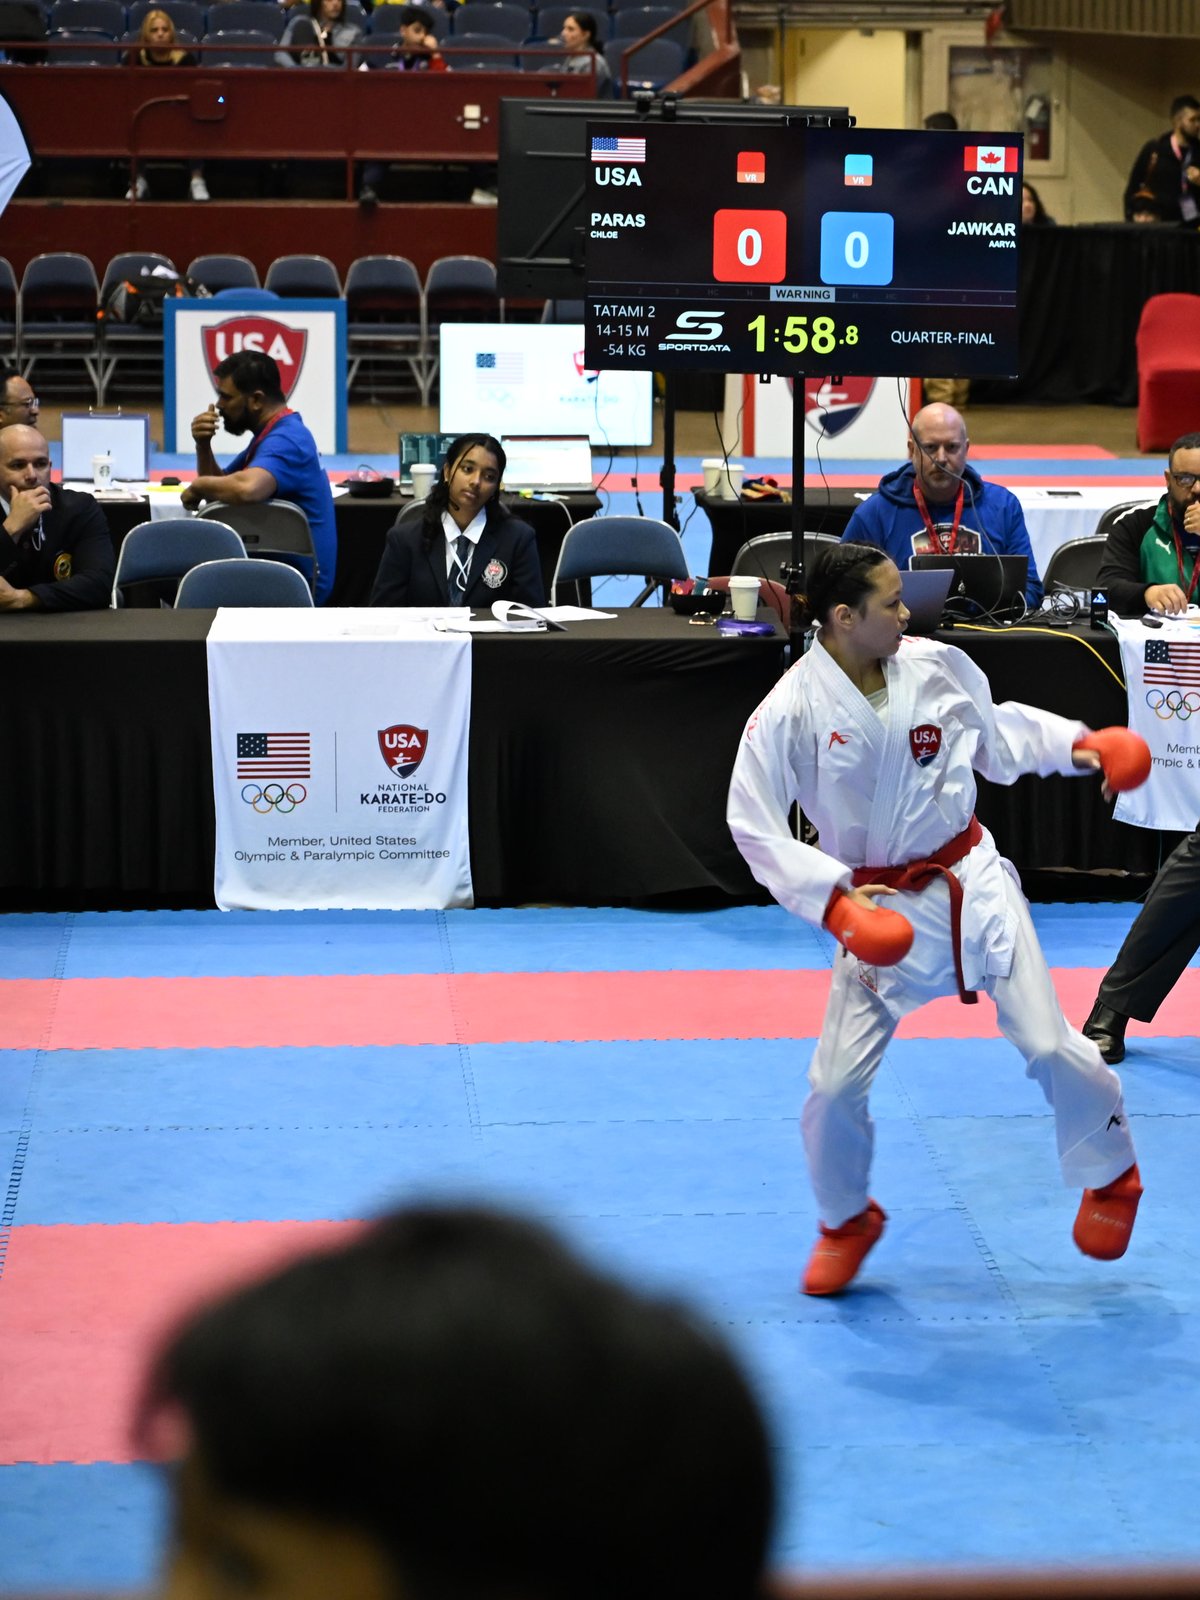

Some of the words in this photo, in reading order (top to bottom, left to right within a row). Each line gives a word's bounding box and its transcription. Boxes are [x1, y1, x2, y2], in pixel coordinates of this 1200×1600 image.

[595, 167, 642, 186] USA
[745, 174, 757, 182] VR
[853, 176, 865, 184] VR
[966, 176, 1014, 196] CAN
[591, 213, 646, 227] PARAS
[590, 231, 618, 239] CHLOE
[947, 222, 1016, 236] JAWKAR
[737, 228, 763, 266] 0
[844, 231, 870, 269] 0
[988, 240, 1016, 248] AARYA
[776, 288, 830, 300] WARNING
[594, 304, 643, 317] TATAMI
[648, 306, 656, 317] 2
[597, 324, 632, 337] 14-15
[637, 325, 649, 336] M
[891, 330, 995, 345] QUARTER-FINAL
[215, 331, 294, 366] USA
[603, 343, 623, 356] -54
[628, 344, 646, 356] KG
[658, 343, 731, 352] SPORTDATA
[385, 733, 421, 749] USA
[913, 731, 938, 744] USA
[1186, 758, 1195, 769] &
[378, 784, 429, 792] NATIONAL
[360, 793, 447, 805] KARATE-DO
[378, 805, 430, 813] FEDERATION
[267, 836, 326, 848] Member,
[330, 836, 372, 846] United
[376, 835, 417, 846] States
[234, 850, 287, 864] Olympic
[290, 851, 300, 861] &
[304, 850, 375, 863] Paralympic
[379, 849, 450, 860] Committee
